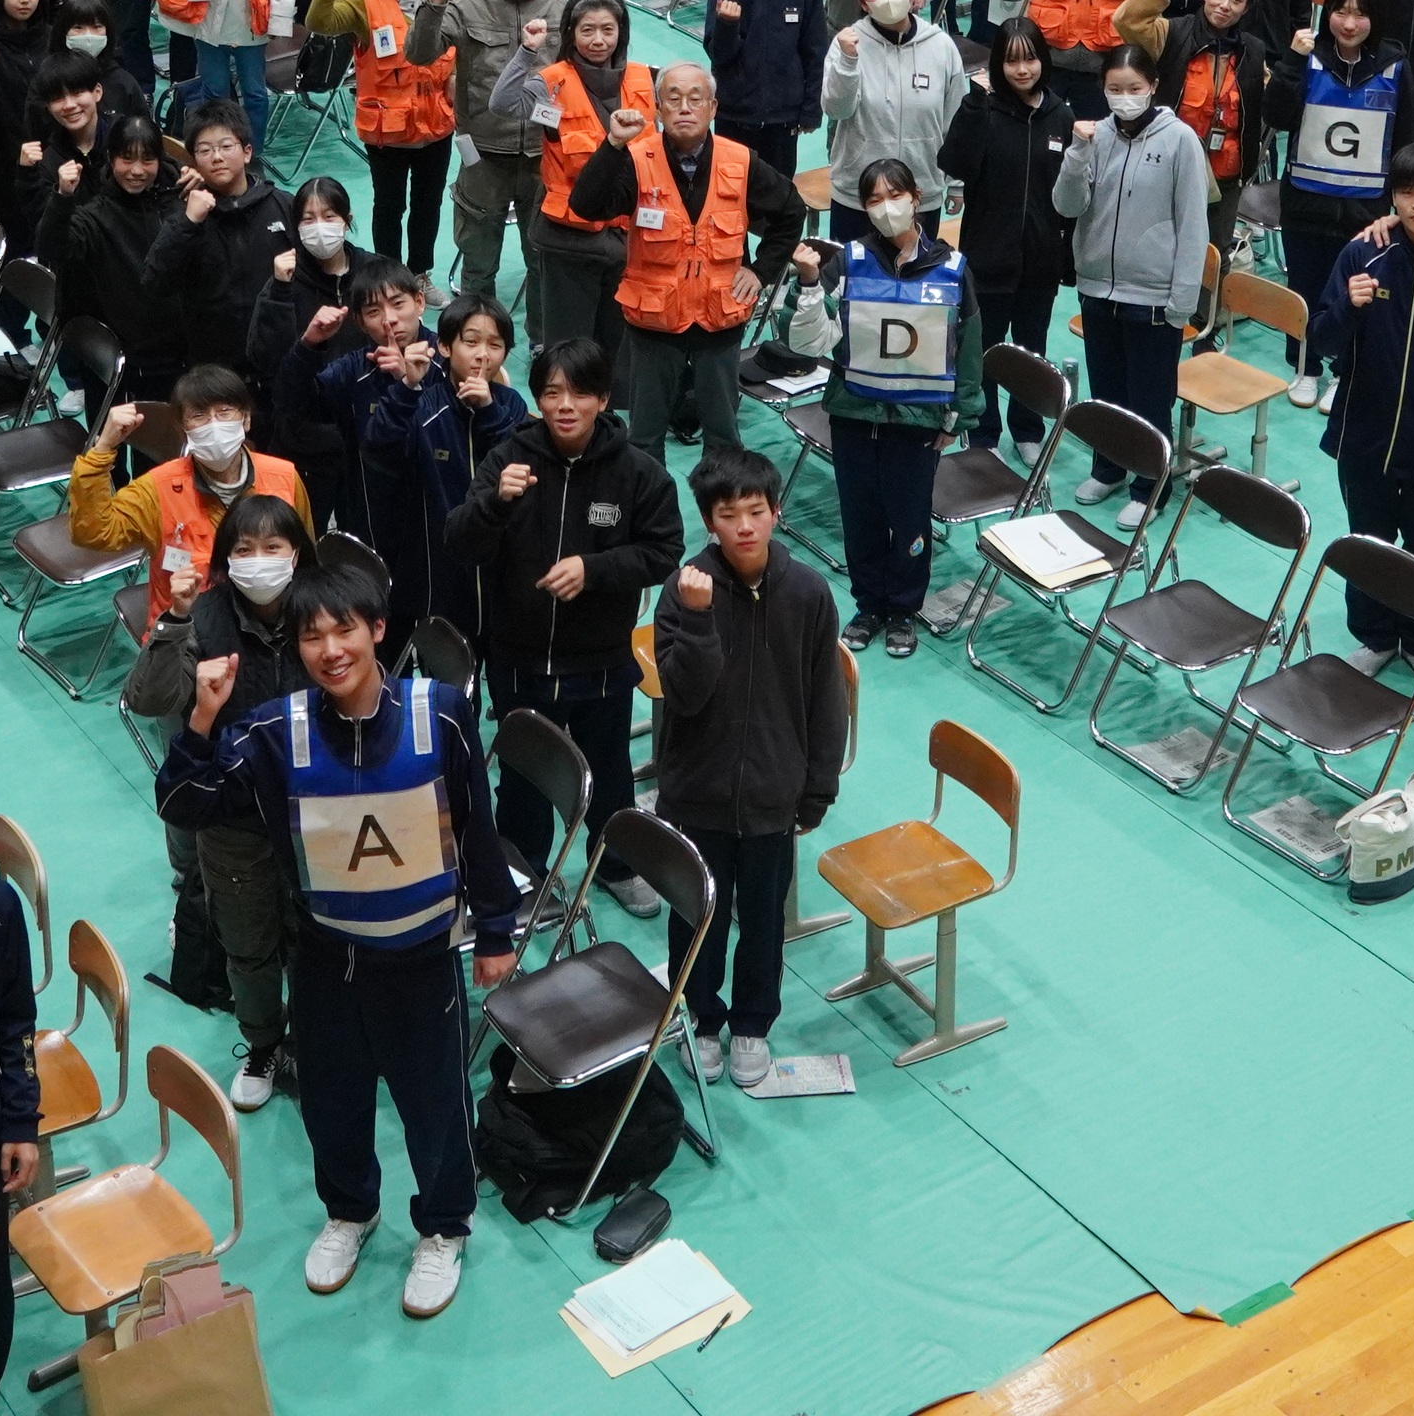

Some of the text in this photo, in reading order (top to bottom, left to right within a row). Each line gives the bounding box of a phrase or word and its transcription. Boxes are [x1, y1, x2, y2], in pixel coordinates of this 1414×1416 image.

[1324, 121, 1360, 159] G
[879, 318, 918, 359] D
[347, 814, 405, 872] A
